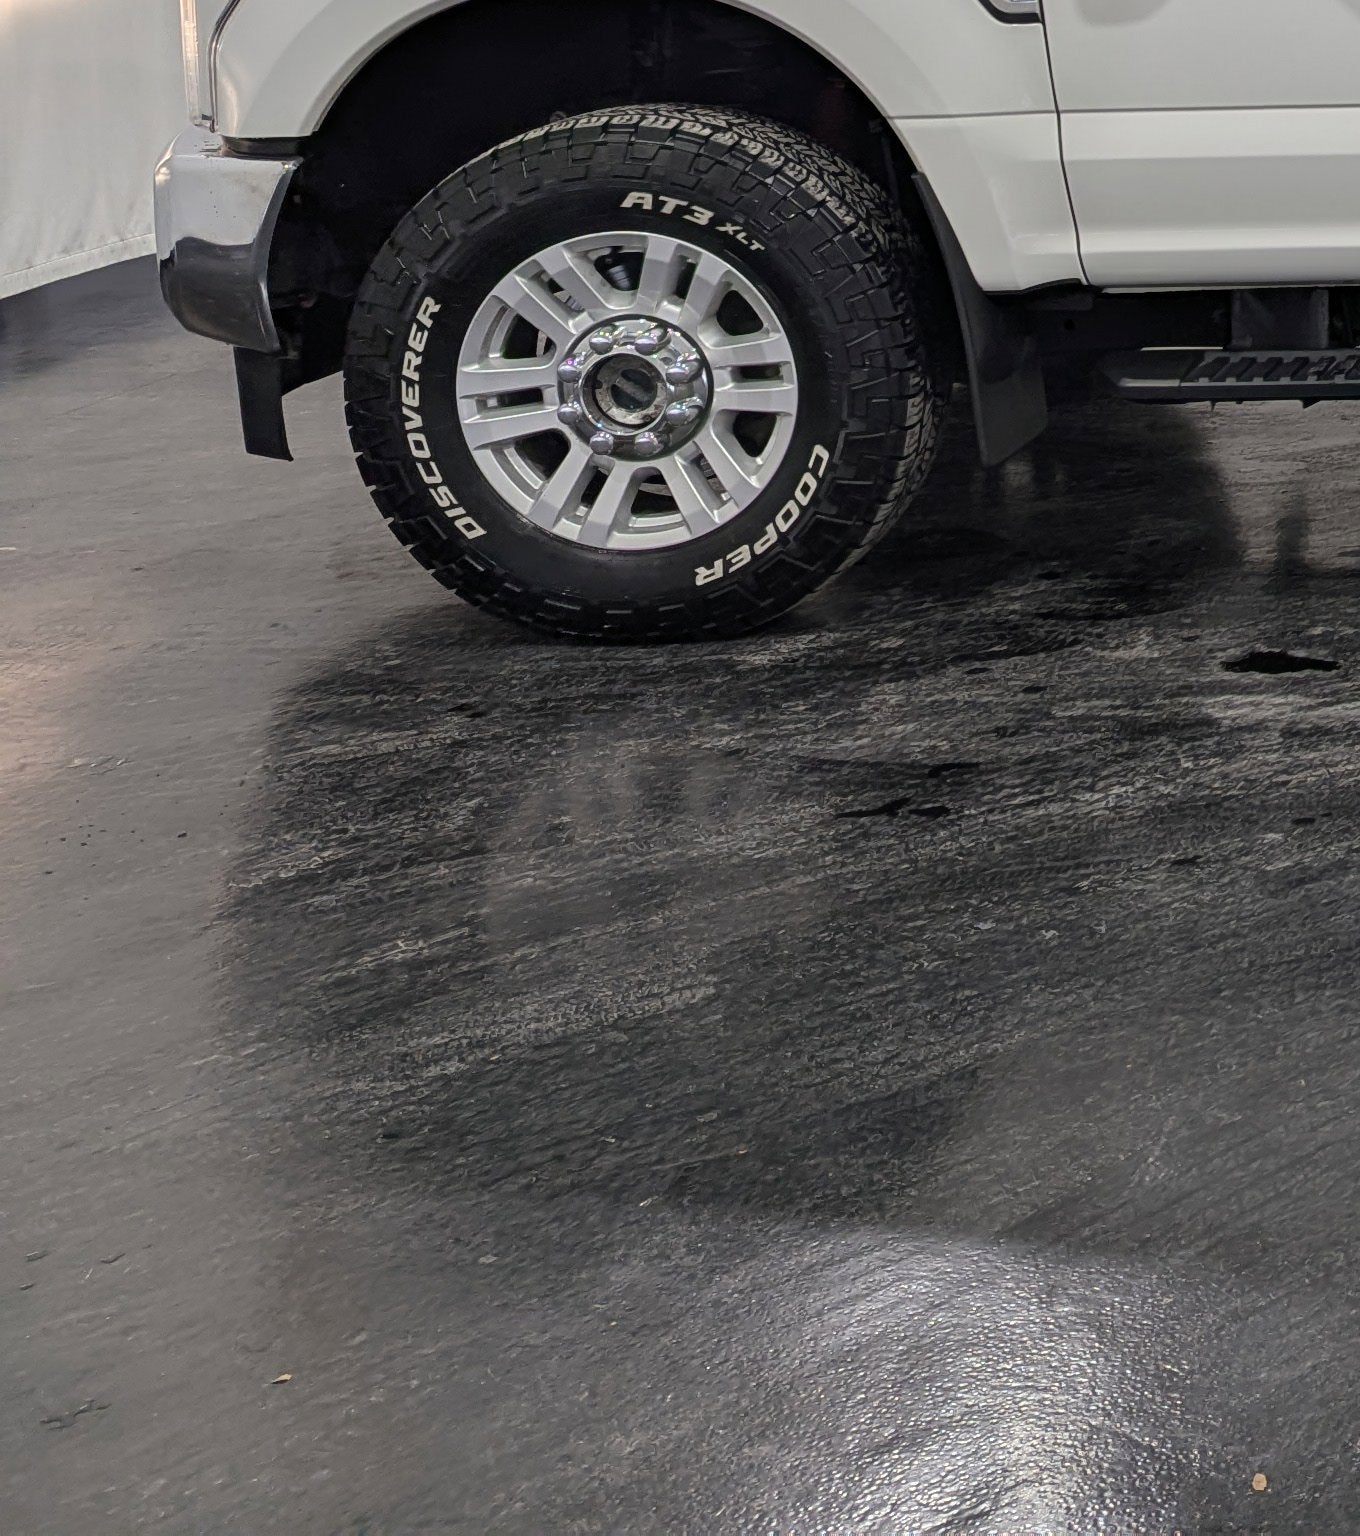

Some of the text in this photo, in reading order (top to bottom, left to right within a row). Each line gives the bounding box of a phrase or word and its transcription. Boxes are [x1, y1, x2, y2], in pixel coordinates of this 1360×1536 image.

[620, 191, 766, 251] AT3 XLT
[401, 295, 487, 541] DISCOVERER
[694, 443, 830, 588] COOPER
